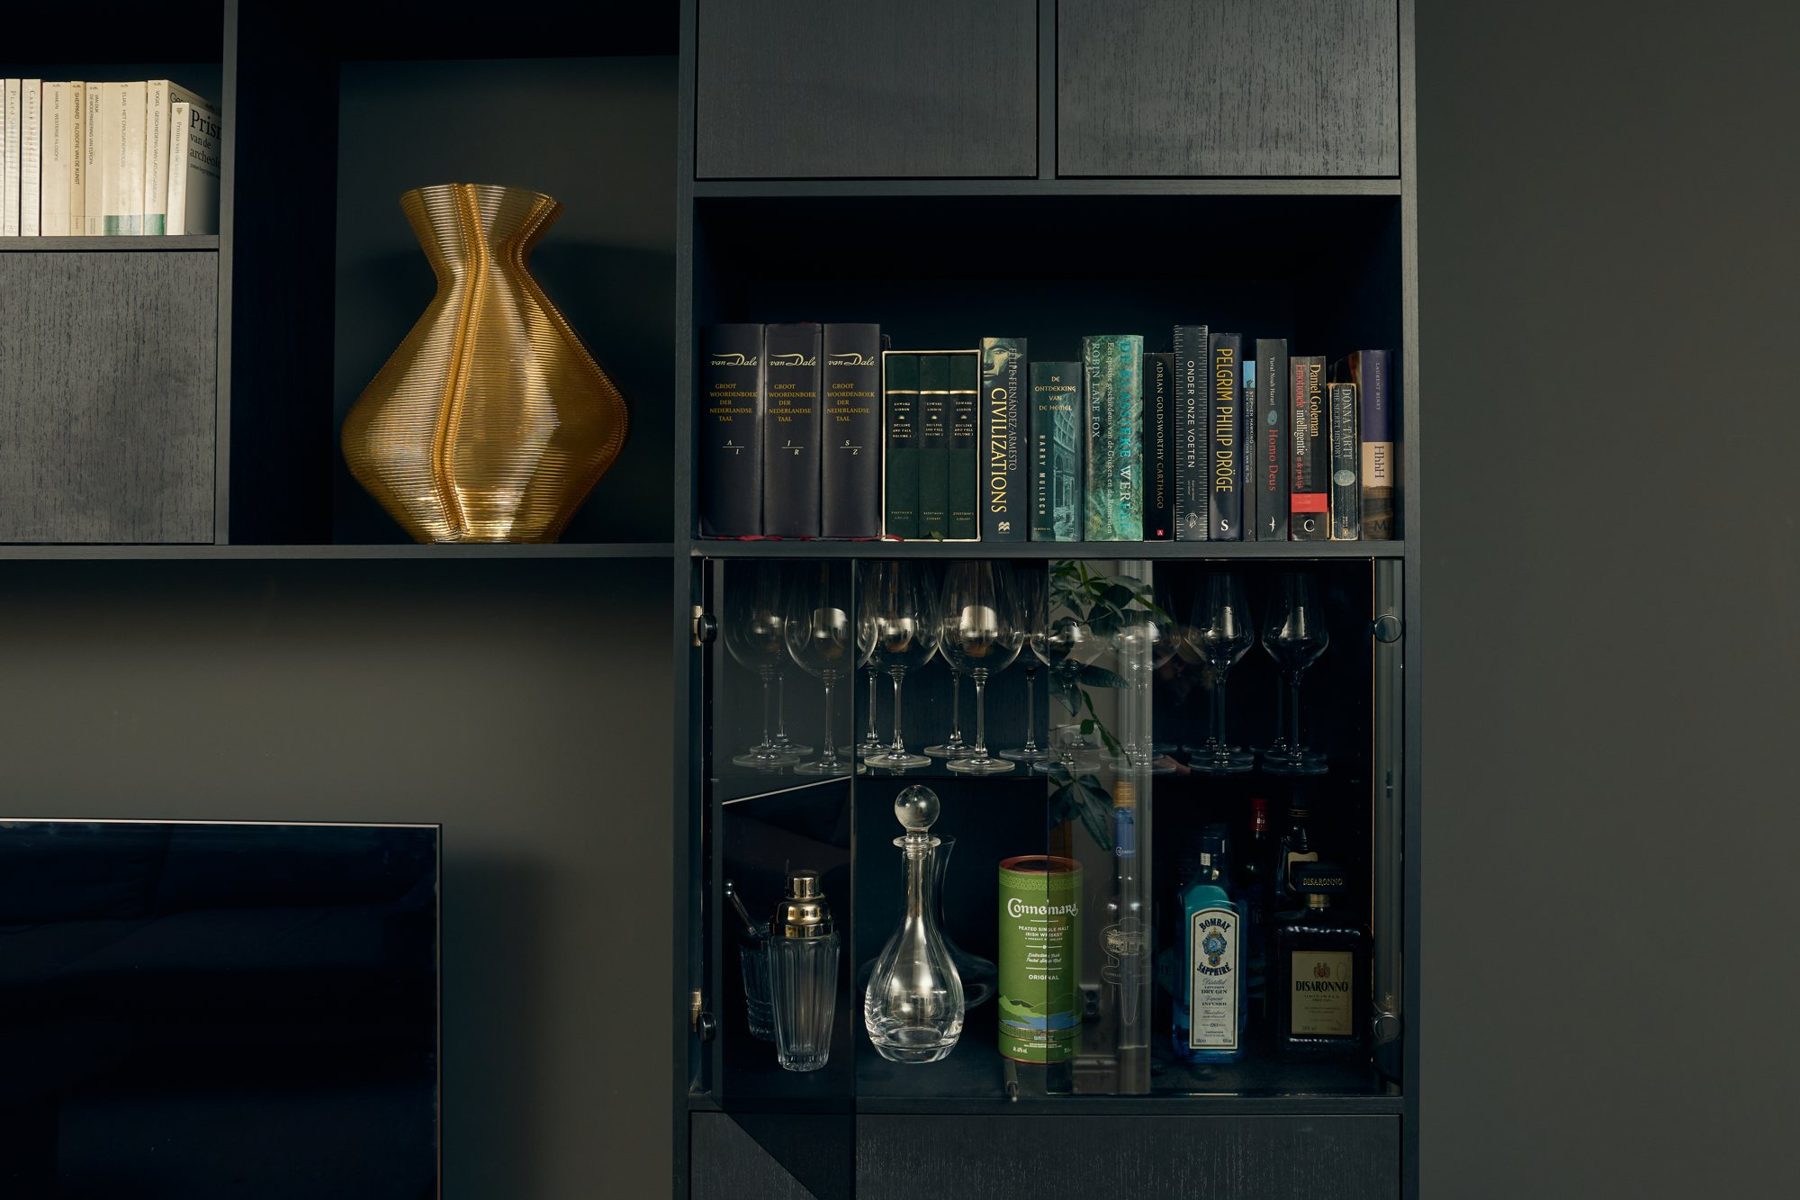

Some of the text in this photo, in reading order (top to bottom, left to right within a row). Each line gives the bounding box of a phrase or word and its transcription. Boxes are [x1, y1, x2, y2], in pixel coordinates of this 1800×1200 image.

[190, 134, 212, 150] van de
[712, 353, 757, 366] Dale
[771, 353, 816, 367] Dale
[829, 353, 875, 367] Dale
[1120, 341, 1132, 361] DE
[1296, 364, 1306, 407] Emotionele
[1008, 348, 1019, 471] FELIPE FERNÁNDEZ-ARMESTO
[1310, 364, 1320, 437] Daniel Goleman
[1120, 369, 1132, 457] KLASSIEKE
[1216, 348, 1235, 492] PELGRIM PHILIP DRÖGE
[1294, 410, 1307, 456] intelligentie
[1342, 389, 1352, 460] DONNA TARTT
[991, 388, 1007, 513] CIVILIZATIONS
[1268, 429, 1278, 491] Homo Deus
[1374, 446, 1384, 478] HhhH
[1107, 479, 1113, 487] en
[1221, 519, 1229, 531] S
[1008, 898, 1078, 918] Connemara
[1199, 918, 1231, 932] BOMBAY
[1197, 962, 1232, 976] SAPPHIRE
[1296, 981, 1348, 992] DISARONNO
